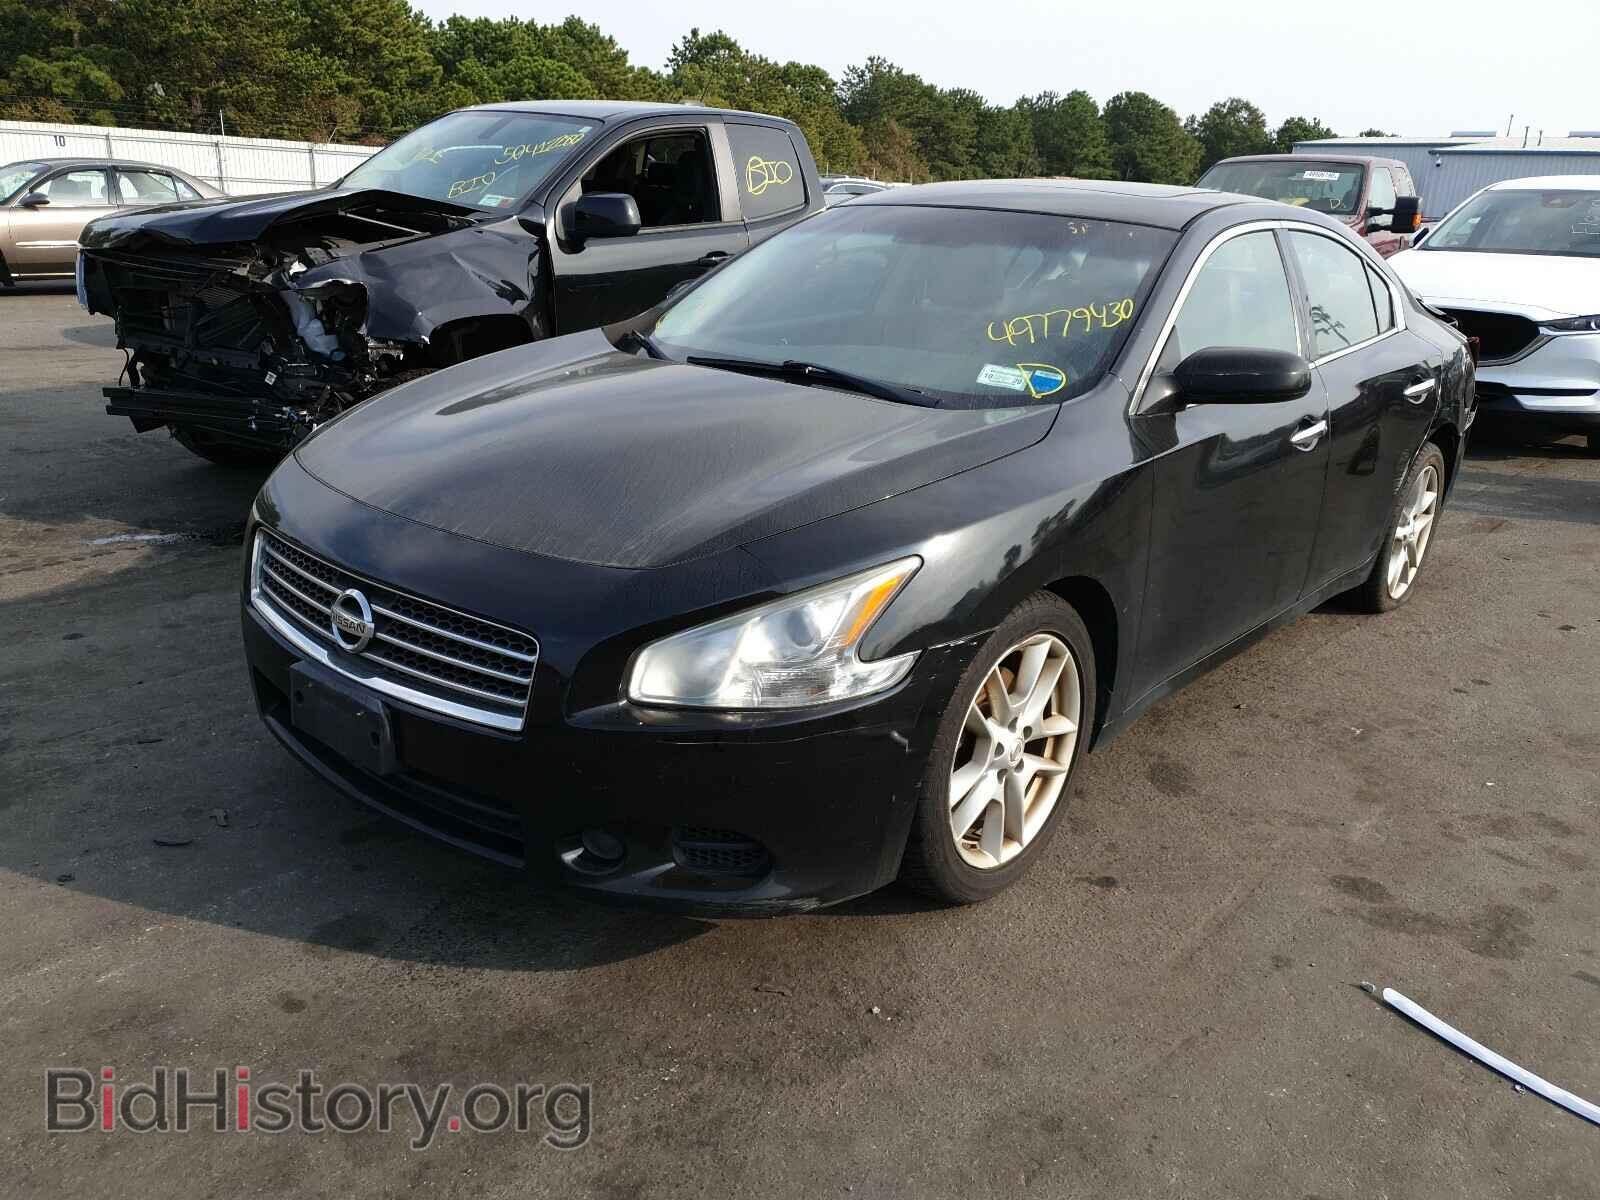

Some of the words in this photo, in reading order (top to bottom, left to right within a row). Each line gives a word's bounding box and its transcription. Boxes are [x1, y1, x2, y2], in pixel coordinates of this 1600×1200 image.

[54, 135, 66, 147] 10
[986, 299, 1134, 345] 49779430
[331, 610, 369, 634] NISSAN
